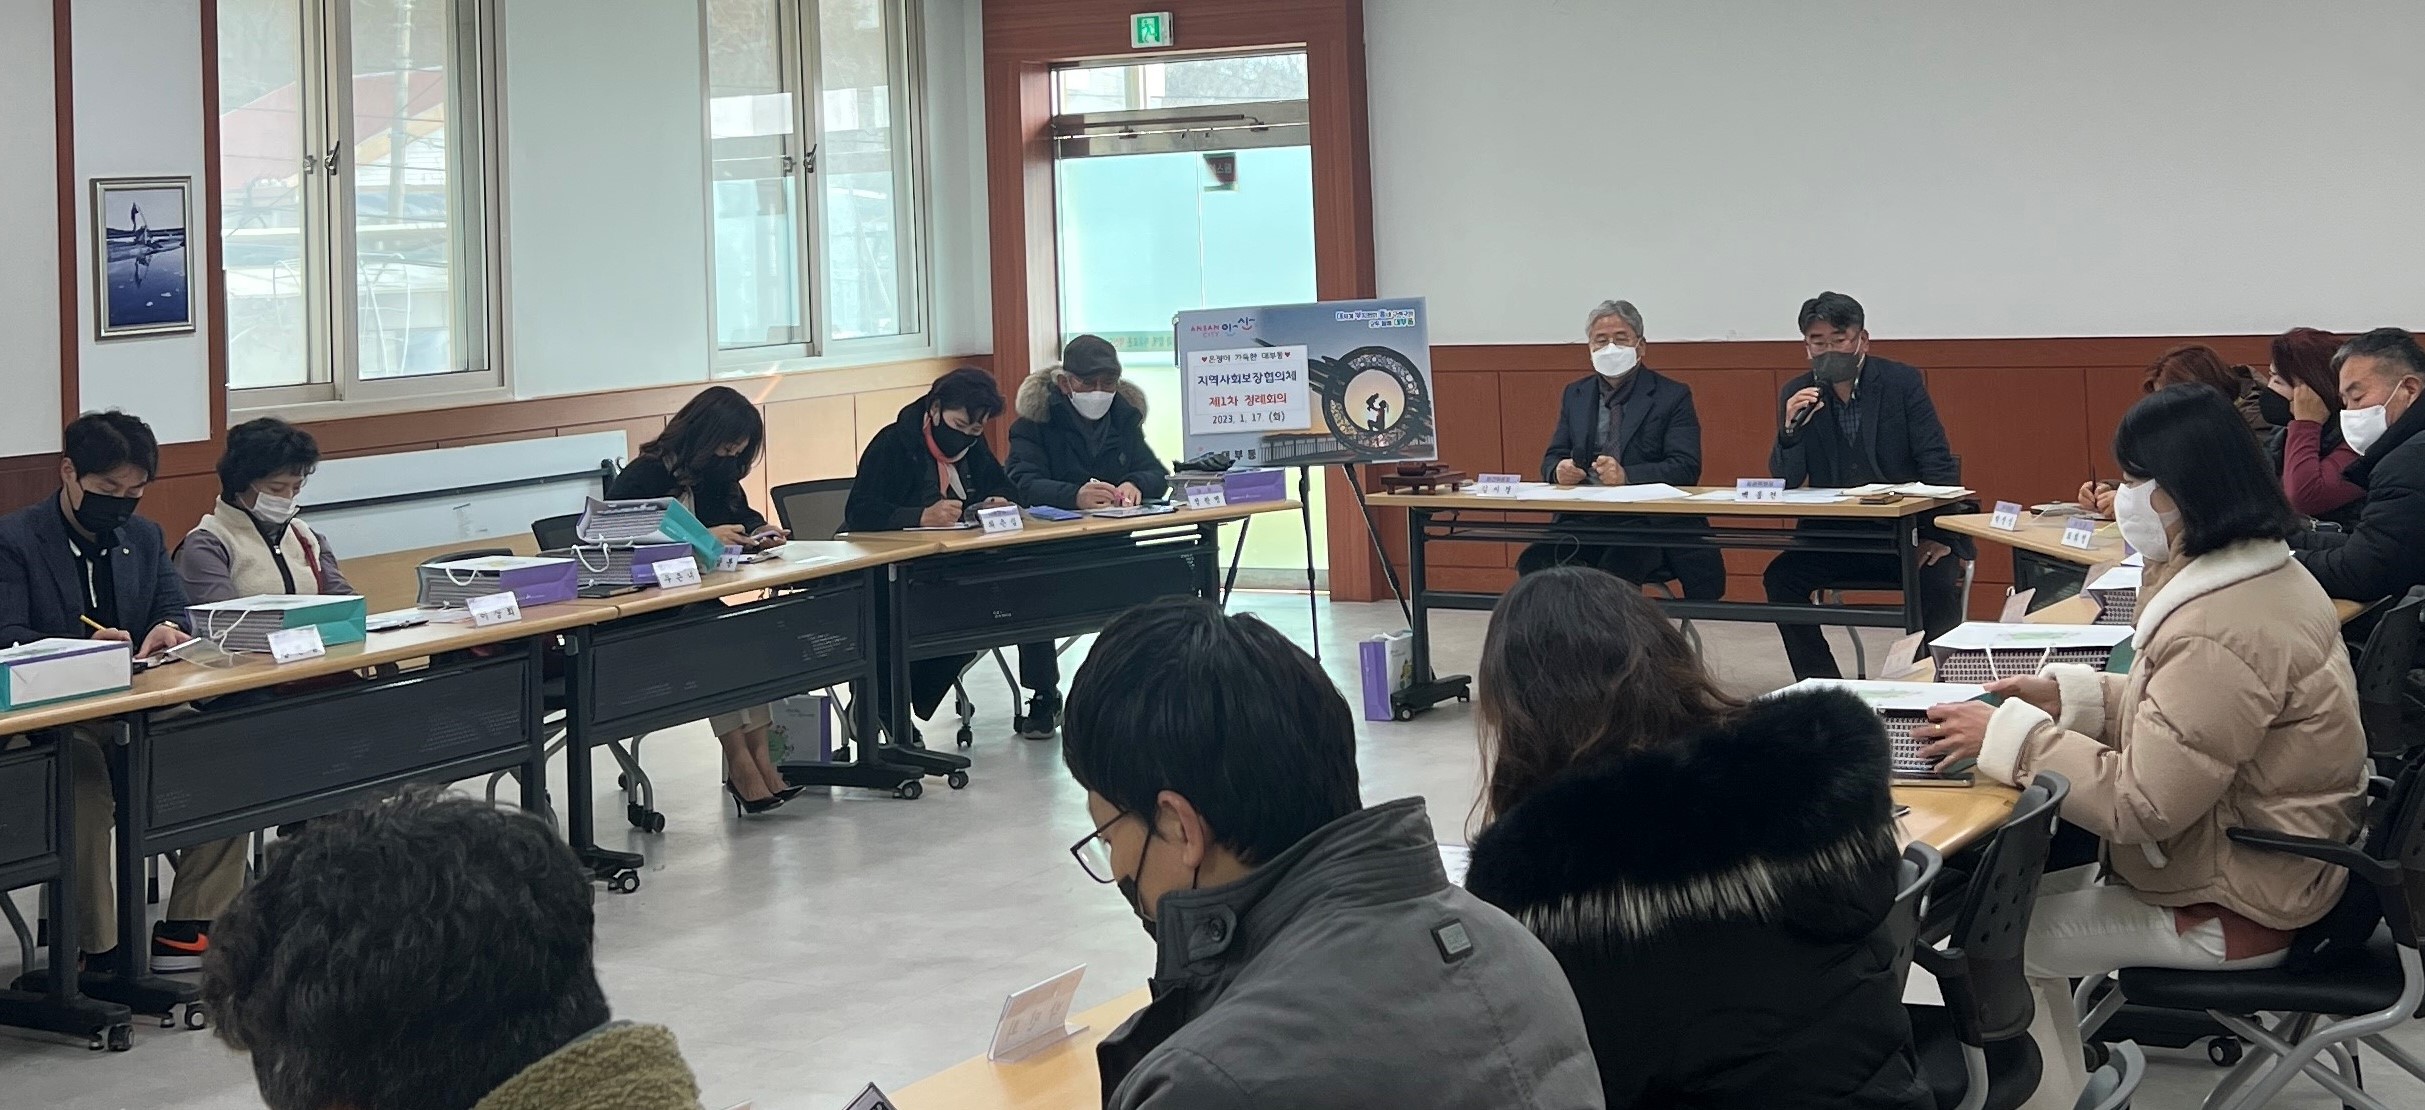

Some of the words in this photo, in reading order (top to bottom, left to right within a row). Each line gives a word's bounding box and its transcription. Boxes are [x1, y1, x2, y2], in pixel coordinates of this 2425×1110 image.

[1235, 352, 1257, 361] 가득한
[1261, 351, 1283, 360] 대부동
[1197, 370, 1297, 386] 지역사회보장협의체
[1209, 395, 1239, 408] 제1차
[1244, 393, 1287, 406] 정례회의
[1268, 410, 1285, 423] (화)
